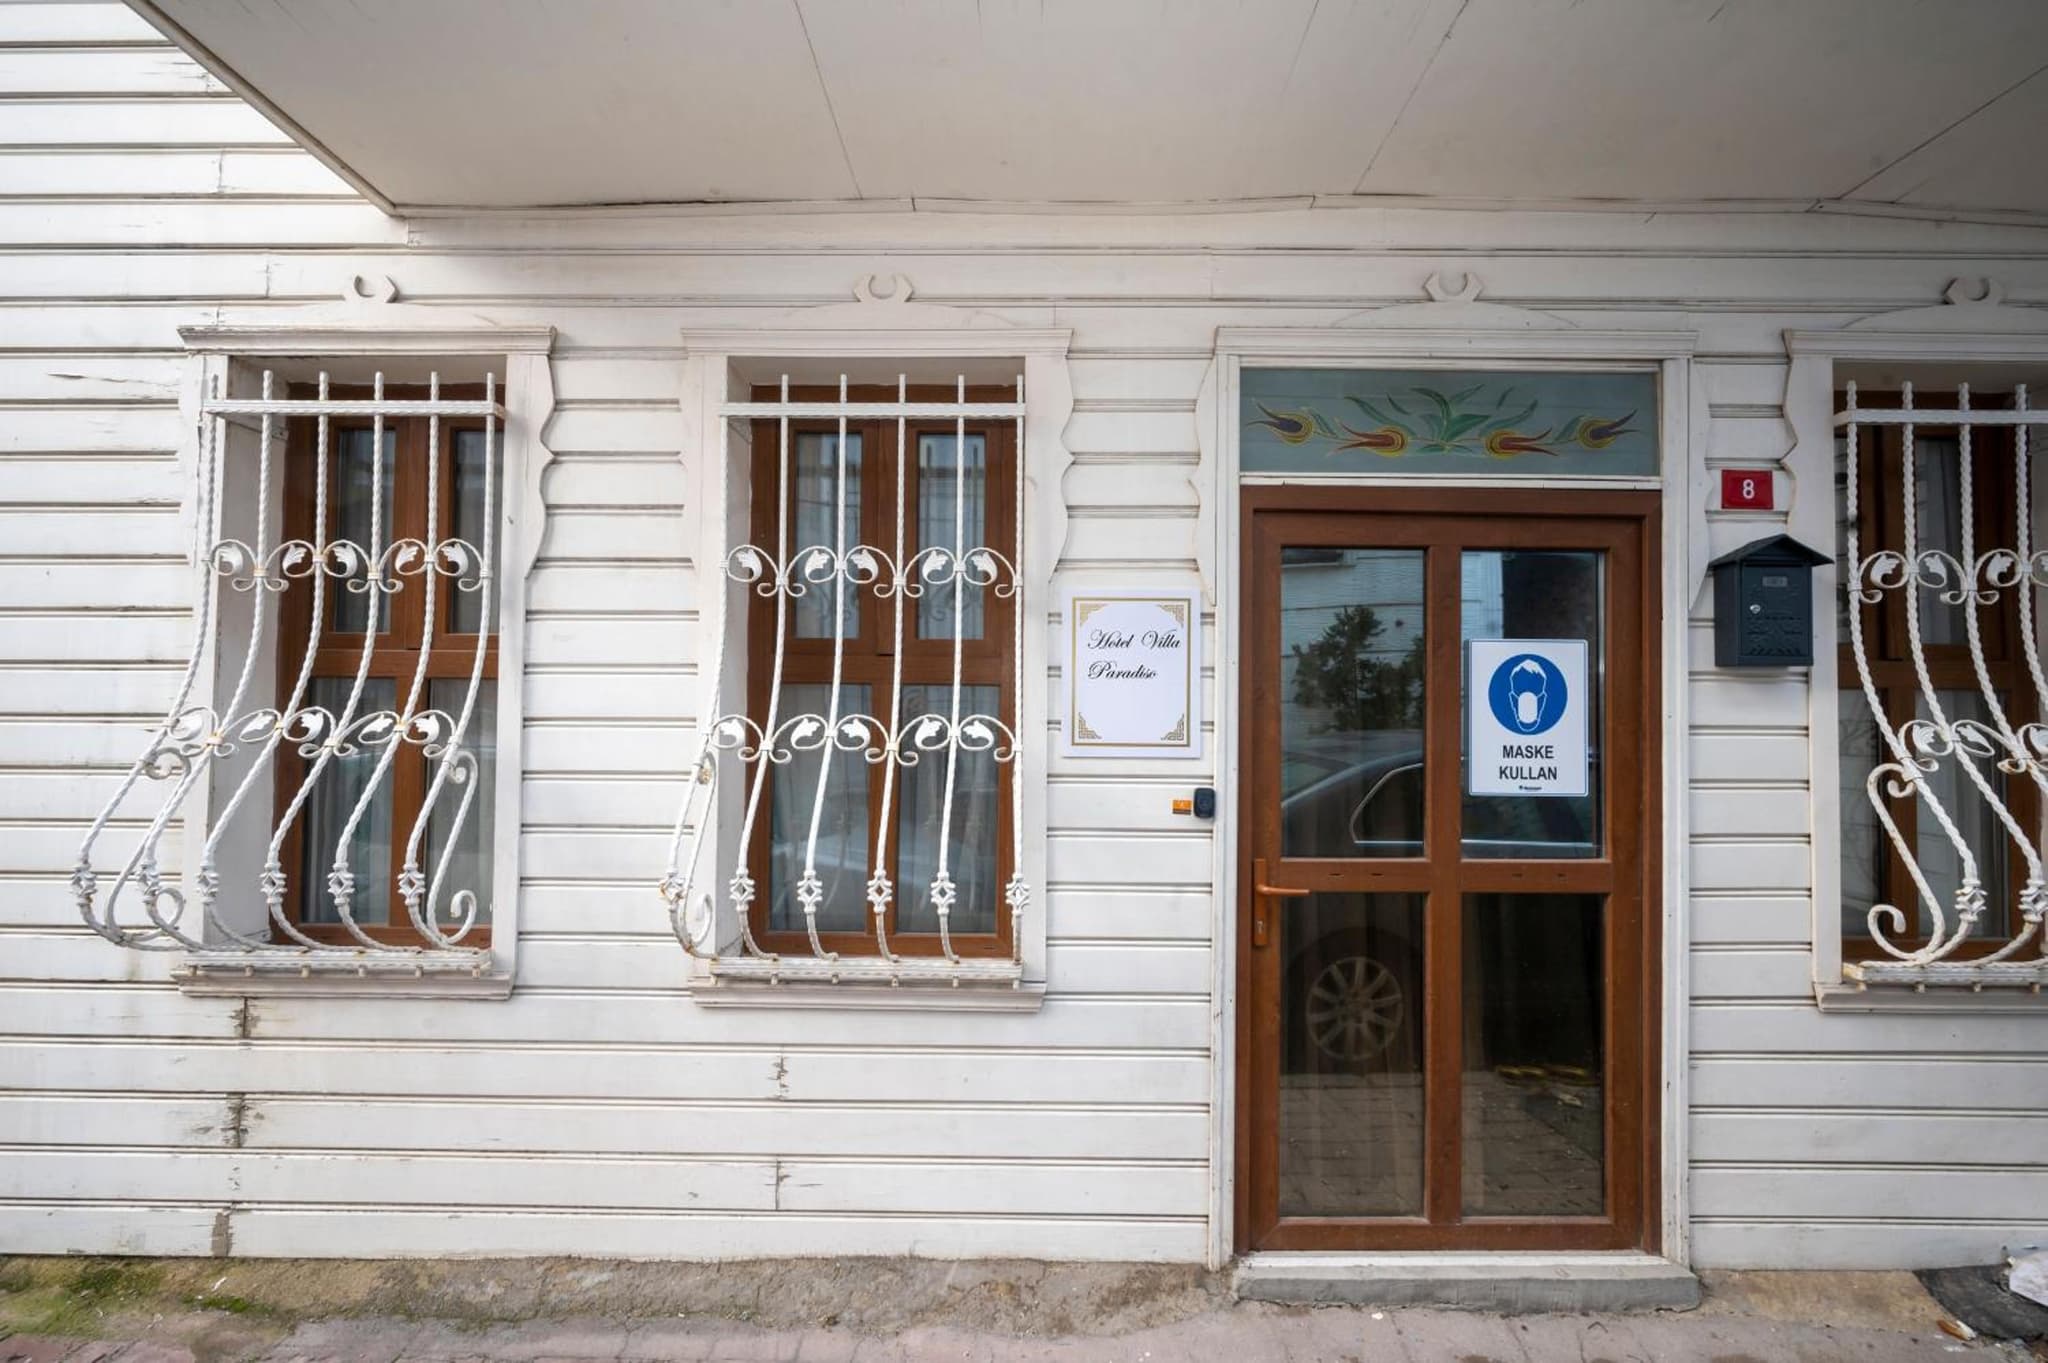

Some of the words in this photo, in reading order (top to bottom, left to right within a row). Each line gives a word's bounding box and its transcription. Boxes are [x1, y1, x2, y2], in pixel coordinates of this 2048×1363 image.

[1742, 479, 1755, 499] 8
[1088, 629, 1134, 650] Hotel
[1141, 629, 1181, 650] Villa
[1088, 660, 1157, 679] Paradiso
[1502, 745, 1554, 759] MASKE
[1499, 766, 1557, 780] KULLAN
